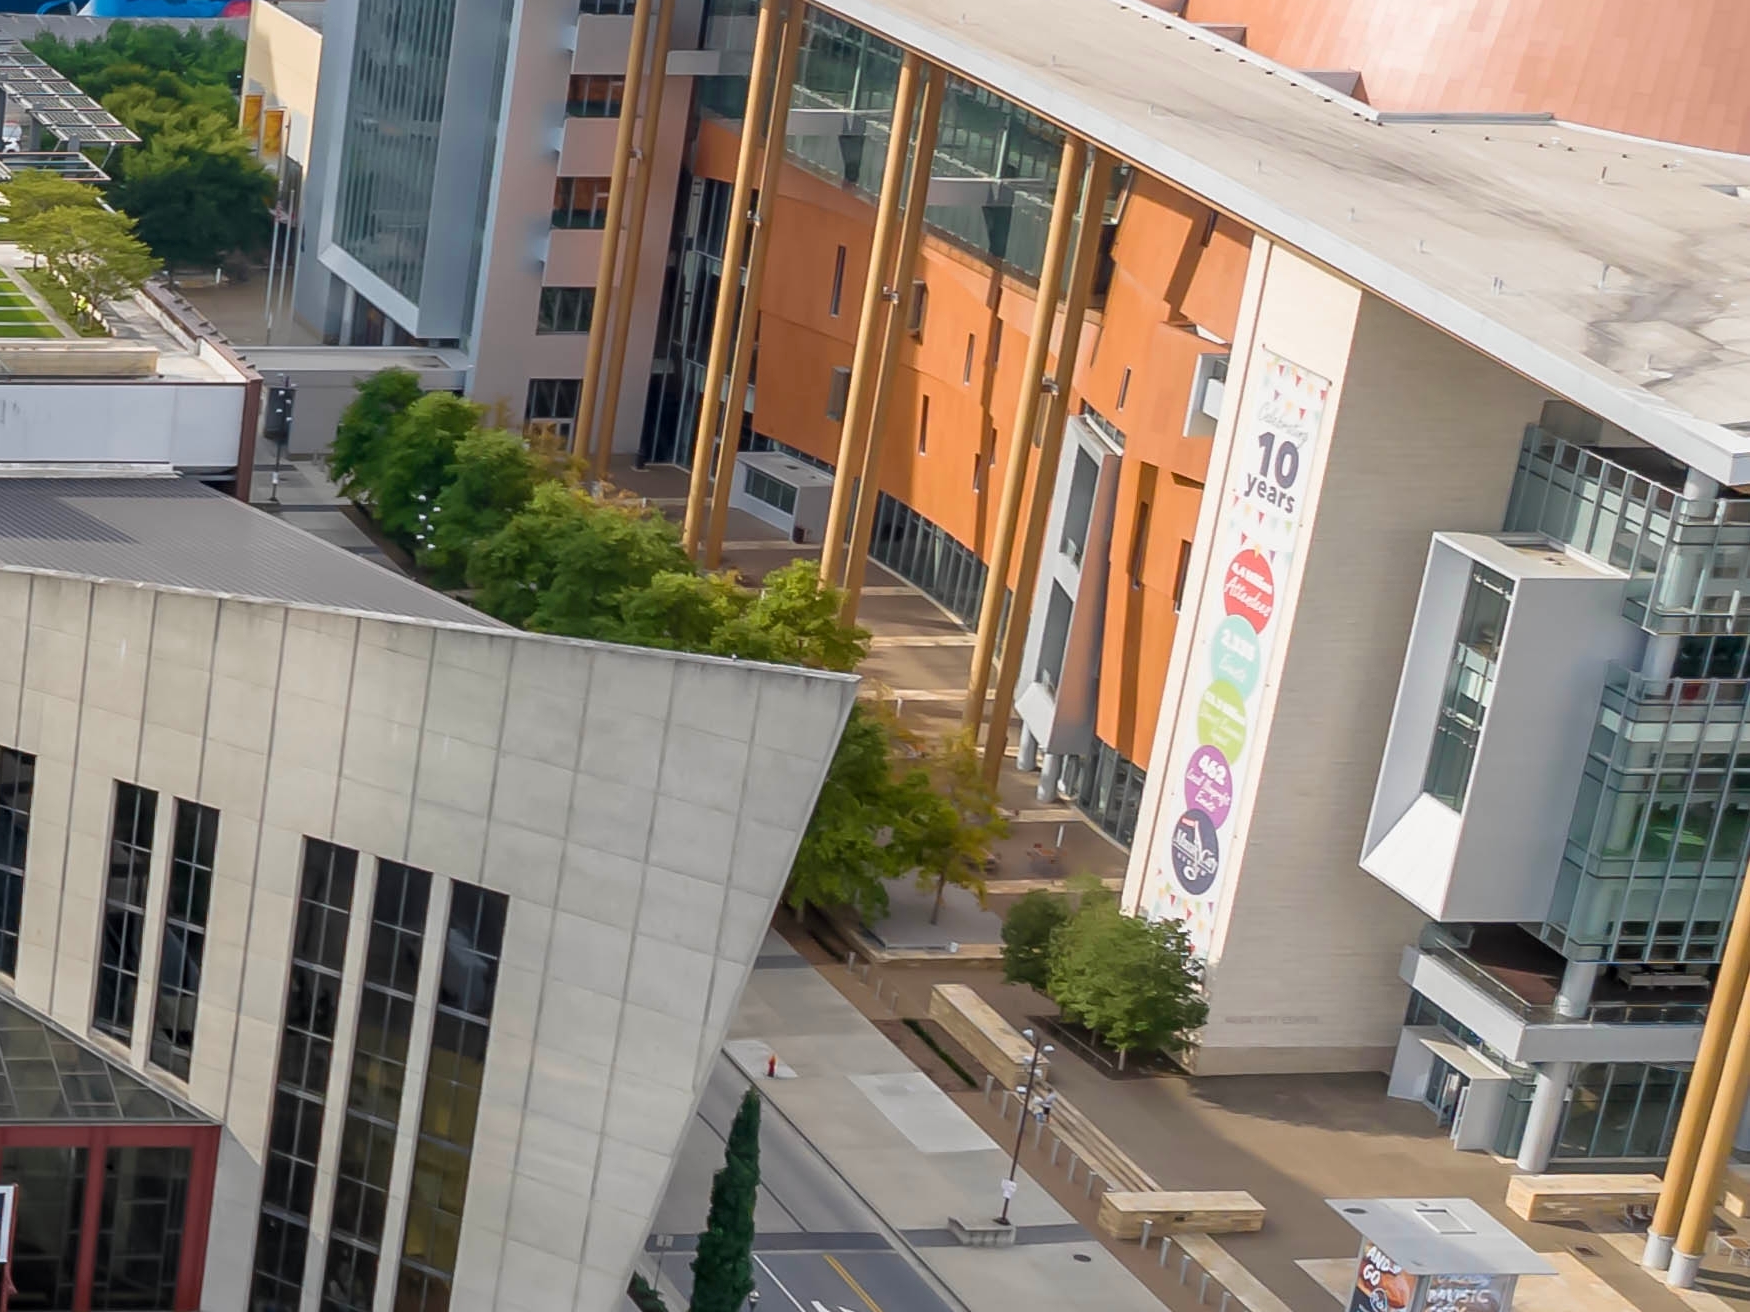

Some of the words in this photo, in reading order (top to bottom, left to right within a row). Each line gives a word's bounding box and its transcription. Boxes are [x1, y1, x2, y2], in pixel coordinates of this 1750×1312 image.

[1258, 432, 1300, 489] 10
[1244, 473, 1295, 513] years
[1363, 1264, 1381, 1286] GO
[1426, 1289, 1492, 1304] MUSIC
